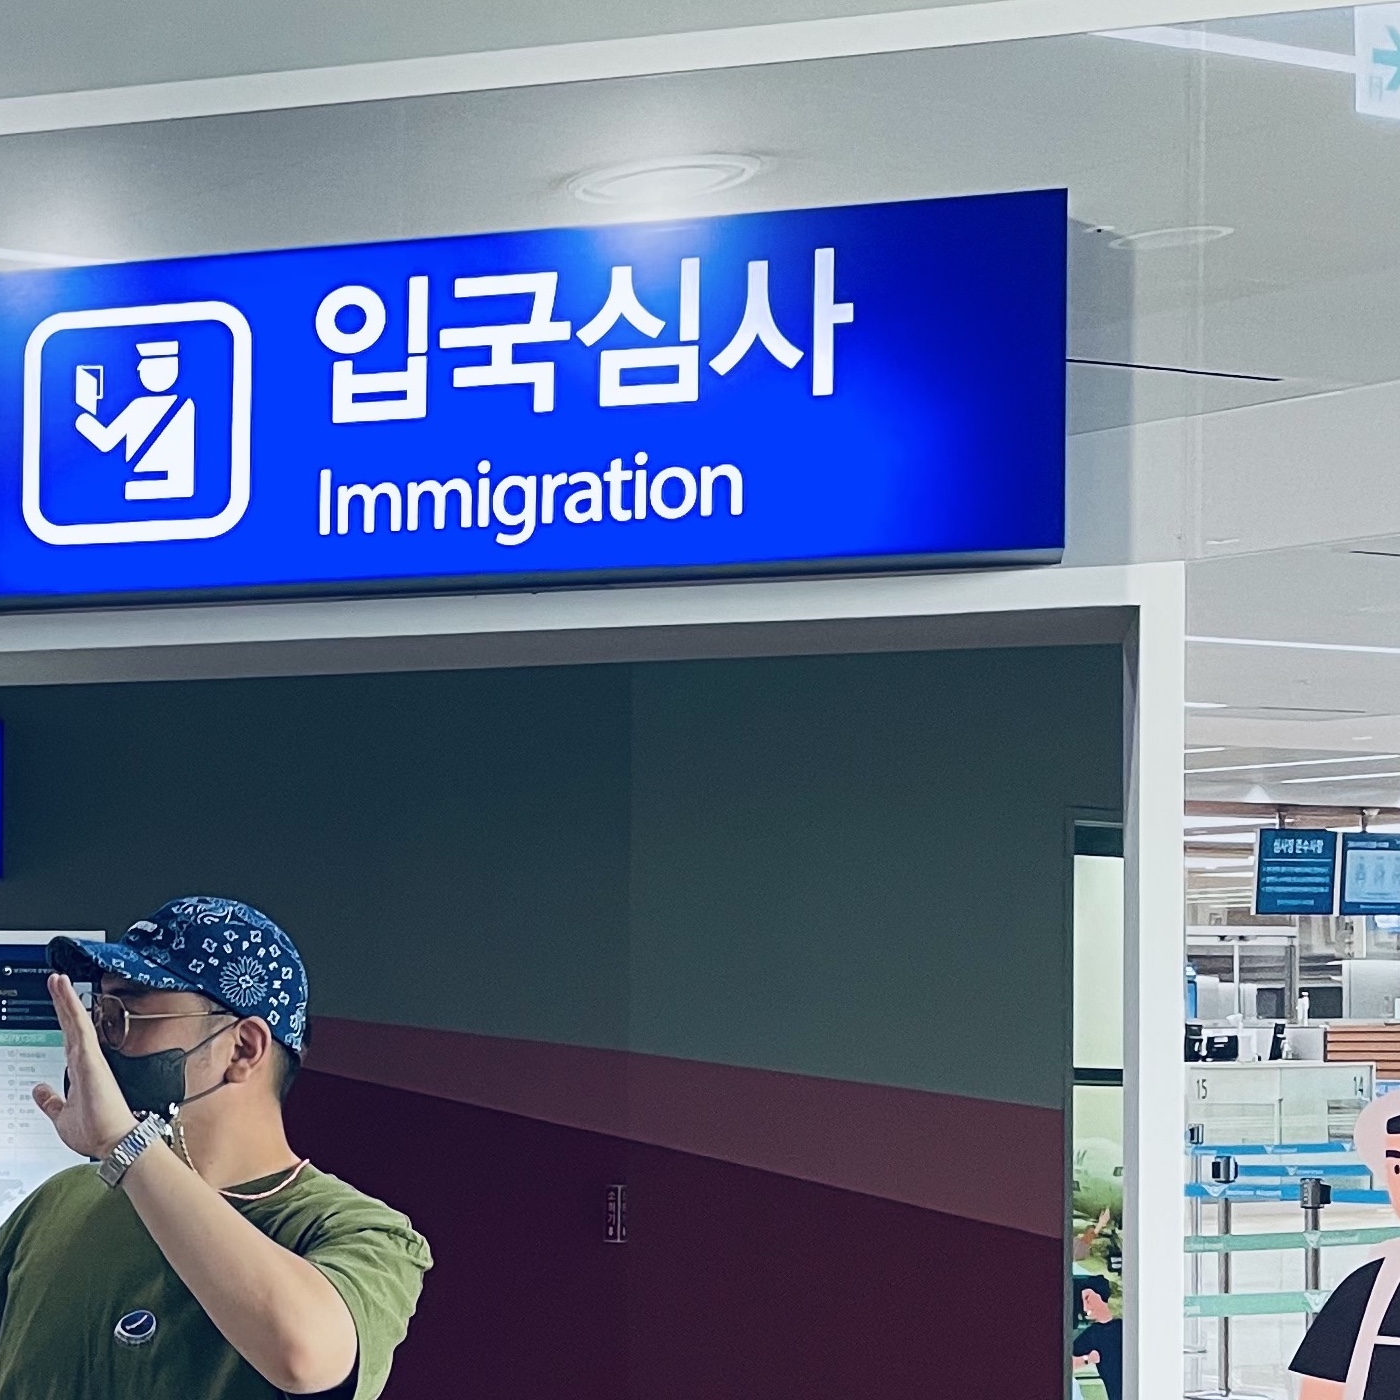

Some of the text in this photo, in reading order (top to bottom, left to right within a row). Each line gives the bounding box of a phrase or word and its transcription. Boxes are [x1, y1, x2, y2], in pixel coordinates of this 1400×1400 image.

[315, 246, 854, 424] 입국심사
[319, 451, 743, 546] Immigration
[1196, 1078, 1208, 1100] 15
[1353, 1076, 1364, 1096] 14
